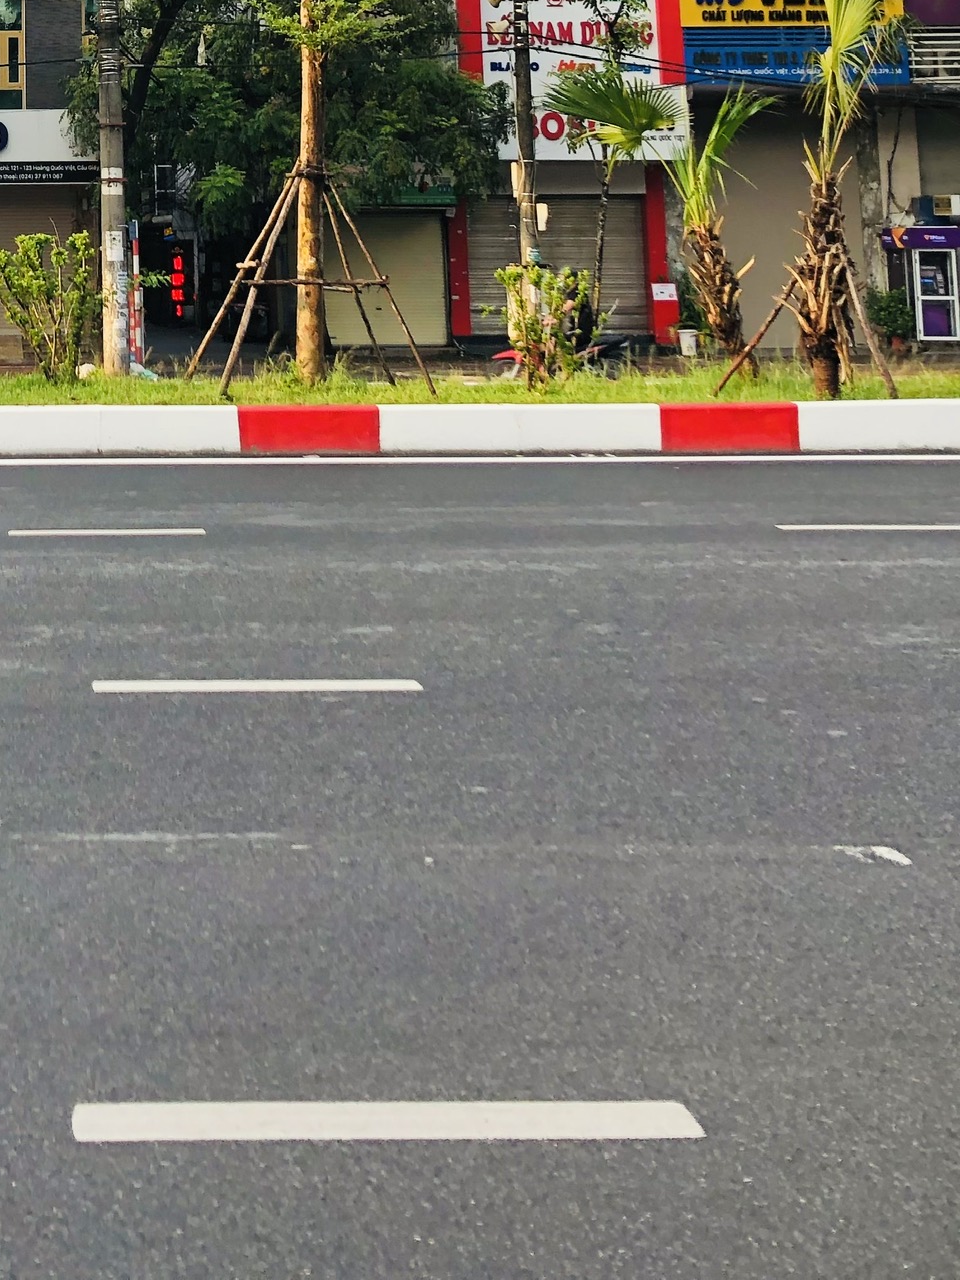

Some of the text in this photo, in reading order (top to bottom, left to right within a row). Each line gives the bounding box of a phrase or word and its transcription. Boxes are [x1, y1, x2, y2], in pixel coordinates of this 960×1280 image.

[528, 21, 574, 46] NAM
[580, 19, 654, 46] DƯG
[490, 62, 539, 72] BLAO
